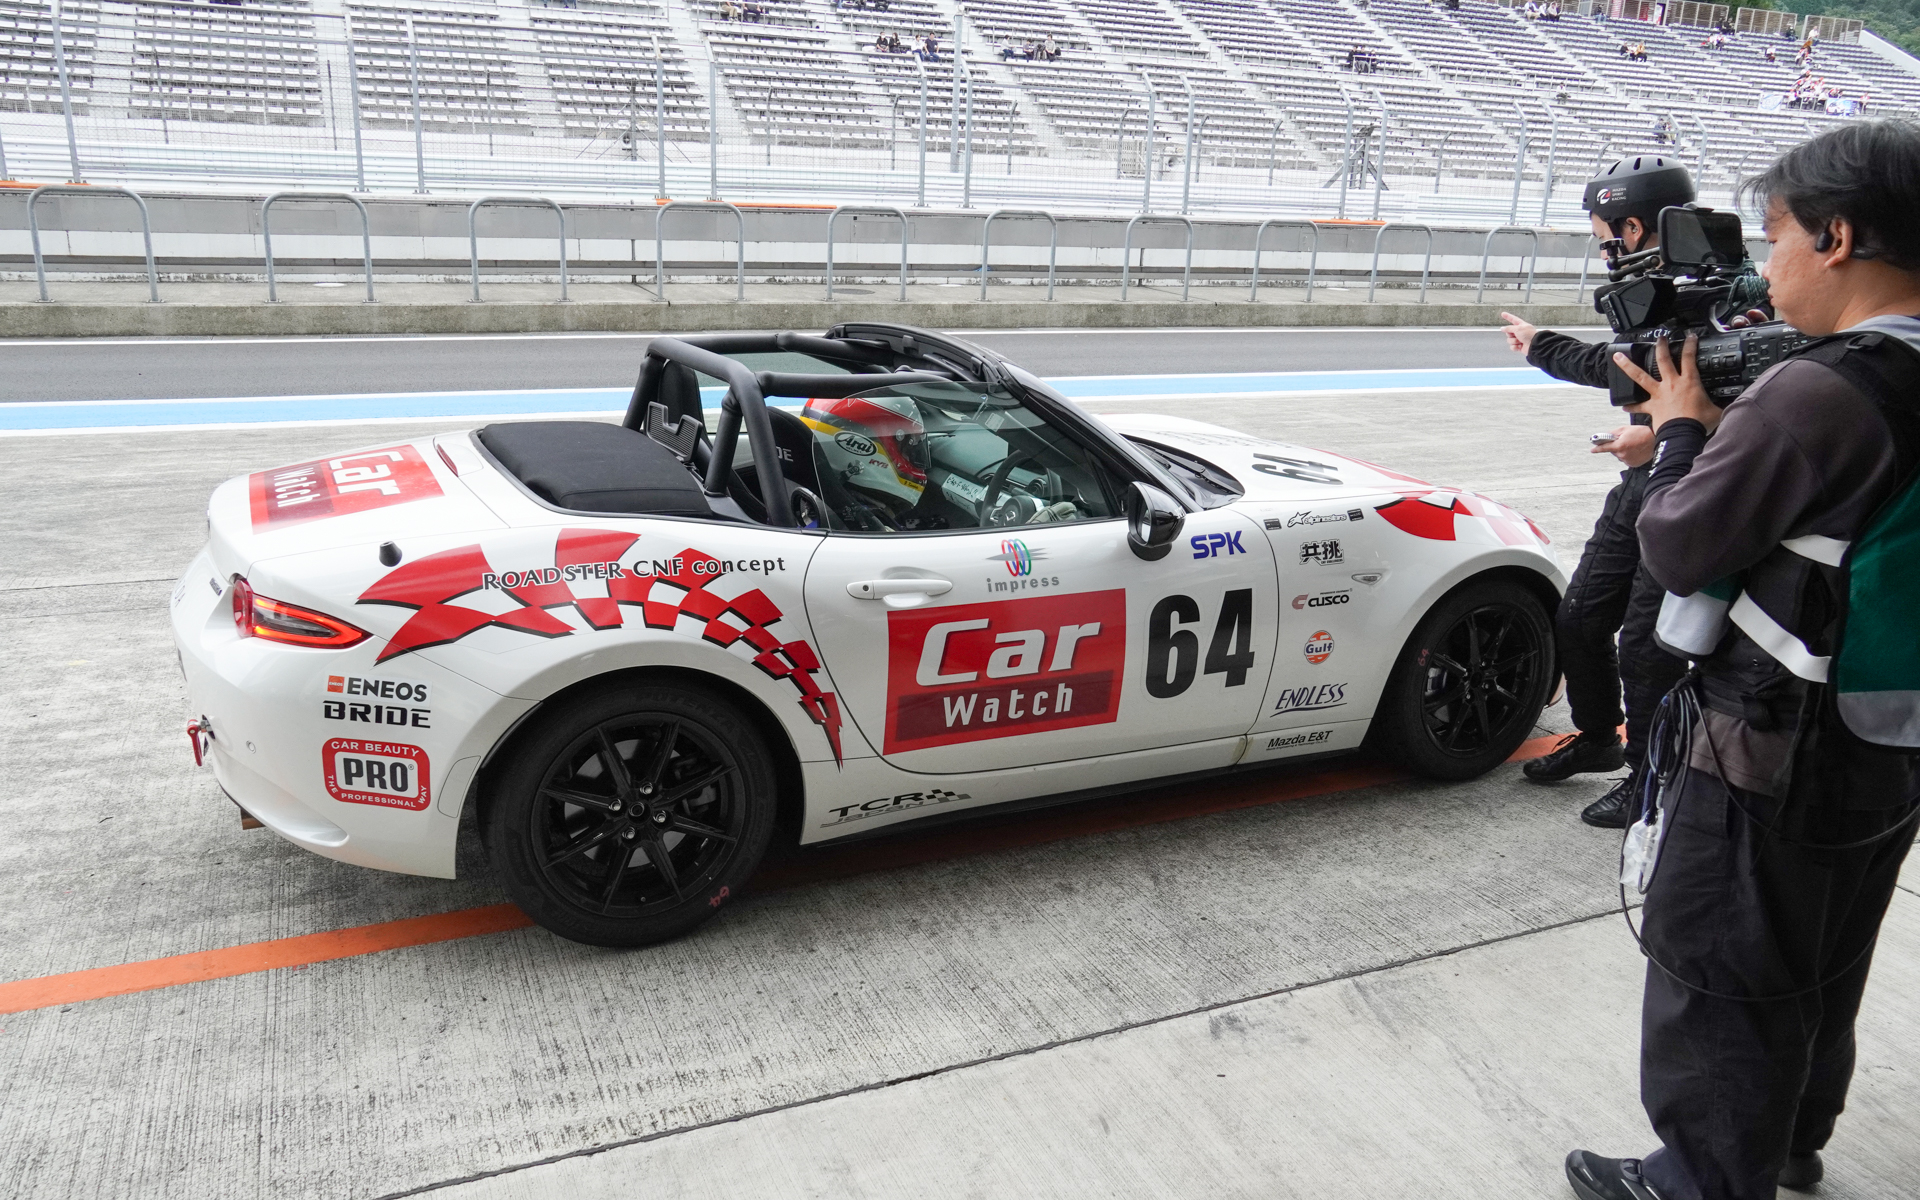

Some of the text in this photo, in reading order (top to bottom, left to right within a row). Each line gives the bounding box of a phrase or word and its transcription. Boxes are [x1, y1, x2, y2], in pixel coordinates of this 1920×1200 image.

[836, 435, 874, 453] Arai
[328, 451, 404, 496] Car
[1251, 452, 1344, 486] 64
[273, 467, 321, 508] Watch
[1190, 530, 1247, 560] SPK
[482, 555, 786, 590] ROADSTER CNF concept
[986, 575, 1061, 593] impress
[915, 617, 1103, 687] Car
[1145, 587, 1256, 699] 64
[1305, 642, 1333, 654] Gulf
[347, 677, 428, 702] ENEOS
[1274, 682, 1348, 710] ENDLESS
[322, 700, 431, 729] BRIDE
[943, 682, 1074, 728] Watch
[331, 741, 420, 757] CAR BEAUTY
[1267, 734, 1306, 748] Mazda
[1307, 730, 1334, 742] E&T
[343, 757, 409, 793] PRO
[328, 775, 427, 808] THE PROFESSIONAL WAY
[829, 792, 924, 818] TCR
